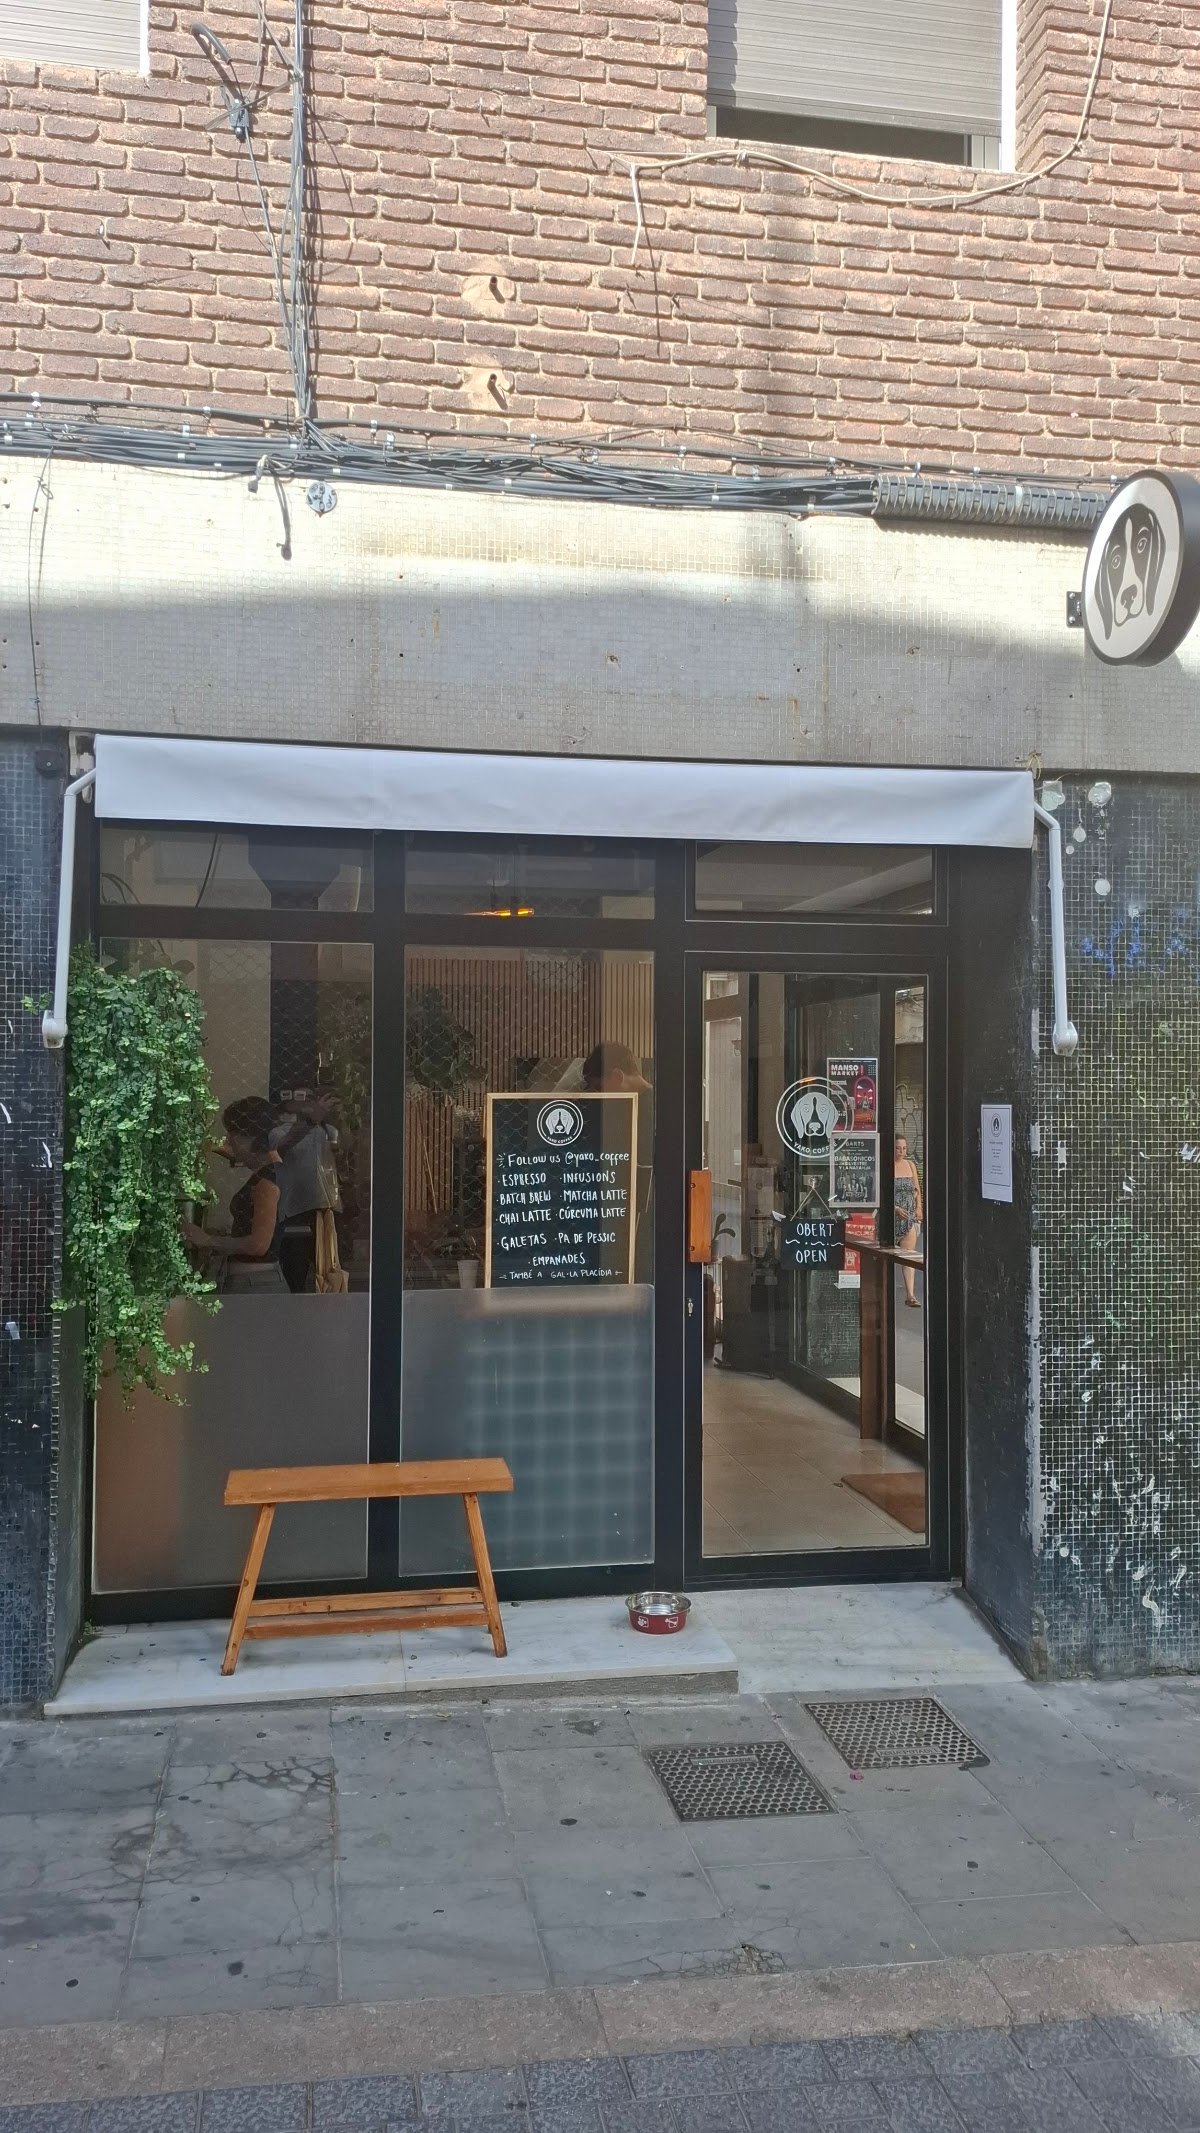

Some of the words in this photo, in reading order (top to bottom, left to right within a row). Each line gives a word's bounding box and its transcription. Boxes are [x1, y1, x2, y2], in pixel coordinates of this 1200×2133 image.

[793, 1141, 811, 1154] YAKO
[502, 1172, 547, 1187] ESPRESSO
[563, 1170, 616, 1184] INFUSIONS
[500, 1192, 526, 1206] BATCH
[529, 1190, 552, 1205] BREW
[563, 1189, 598, 1203] MATCHA
[600, 1189, 628, 1201] LATTE
[499, 1212, 520, 1225] CHAI
[522, 1208, 552, 1222] LATTE
[559, 1206, 599, 1220] CÚRCUMA
[601, 1207, 627, 1218] LATTE
[796, 1222, 835, 1237] OBERT
[501, 1233, 547, 1251] GALETAS
[558, 1232, 571, 1244] PA
[574, 1233, 584, 1244] DE
[587, 1232, 616, 1244] PESSIC
[532, 1252, 586, 1267] EMPANADES
[795, 1249, 827, 1264] OPEN
